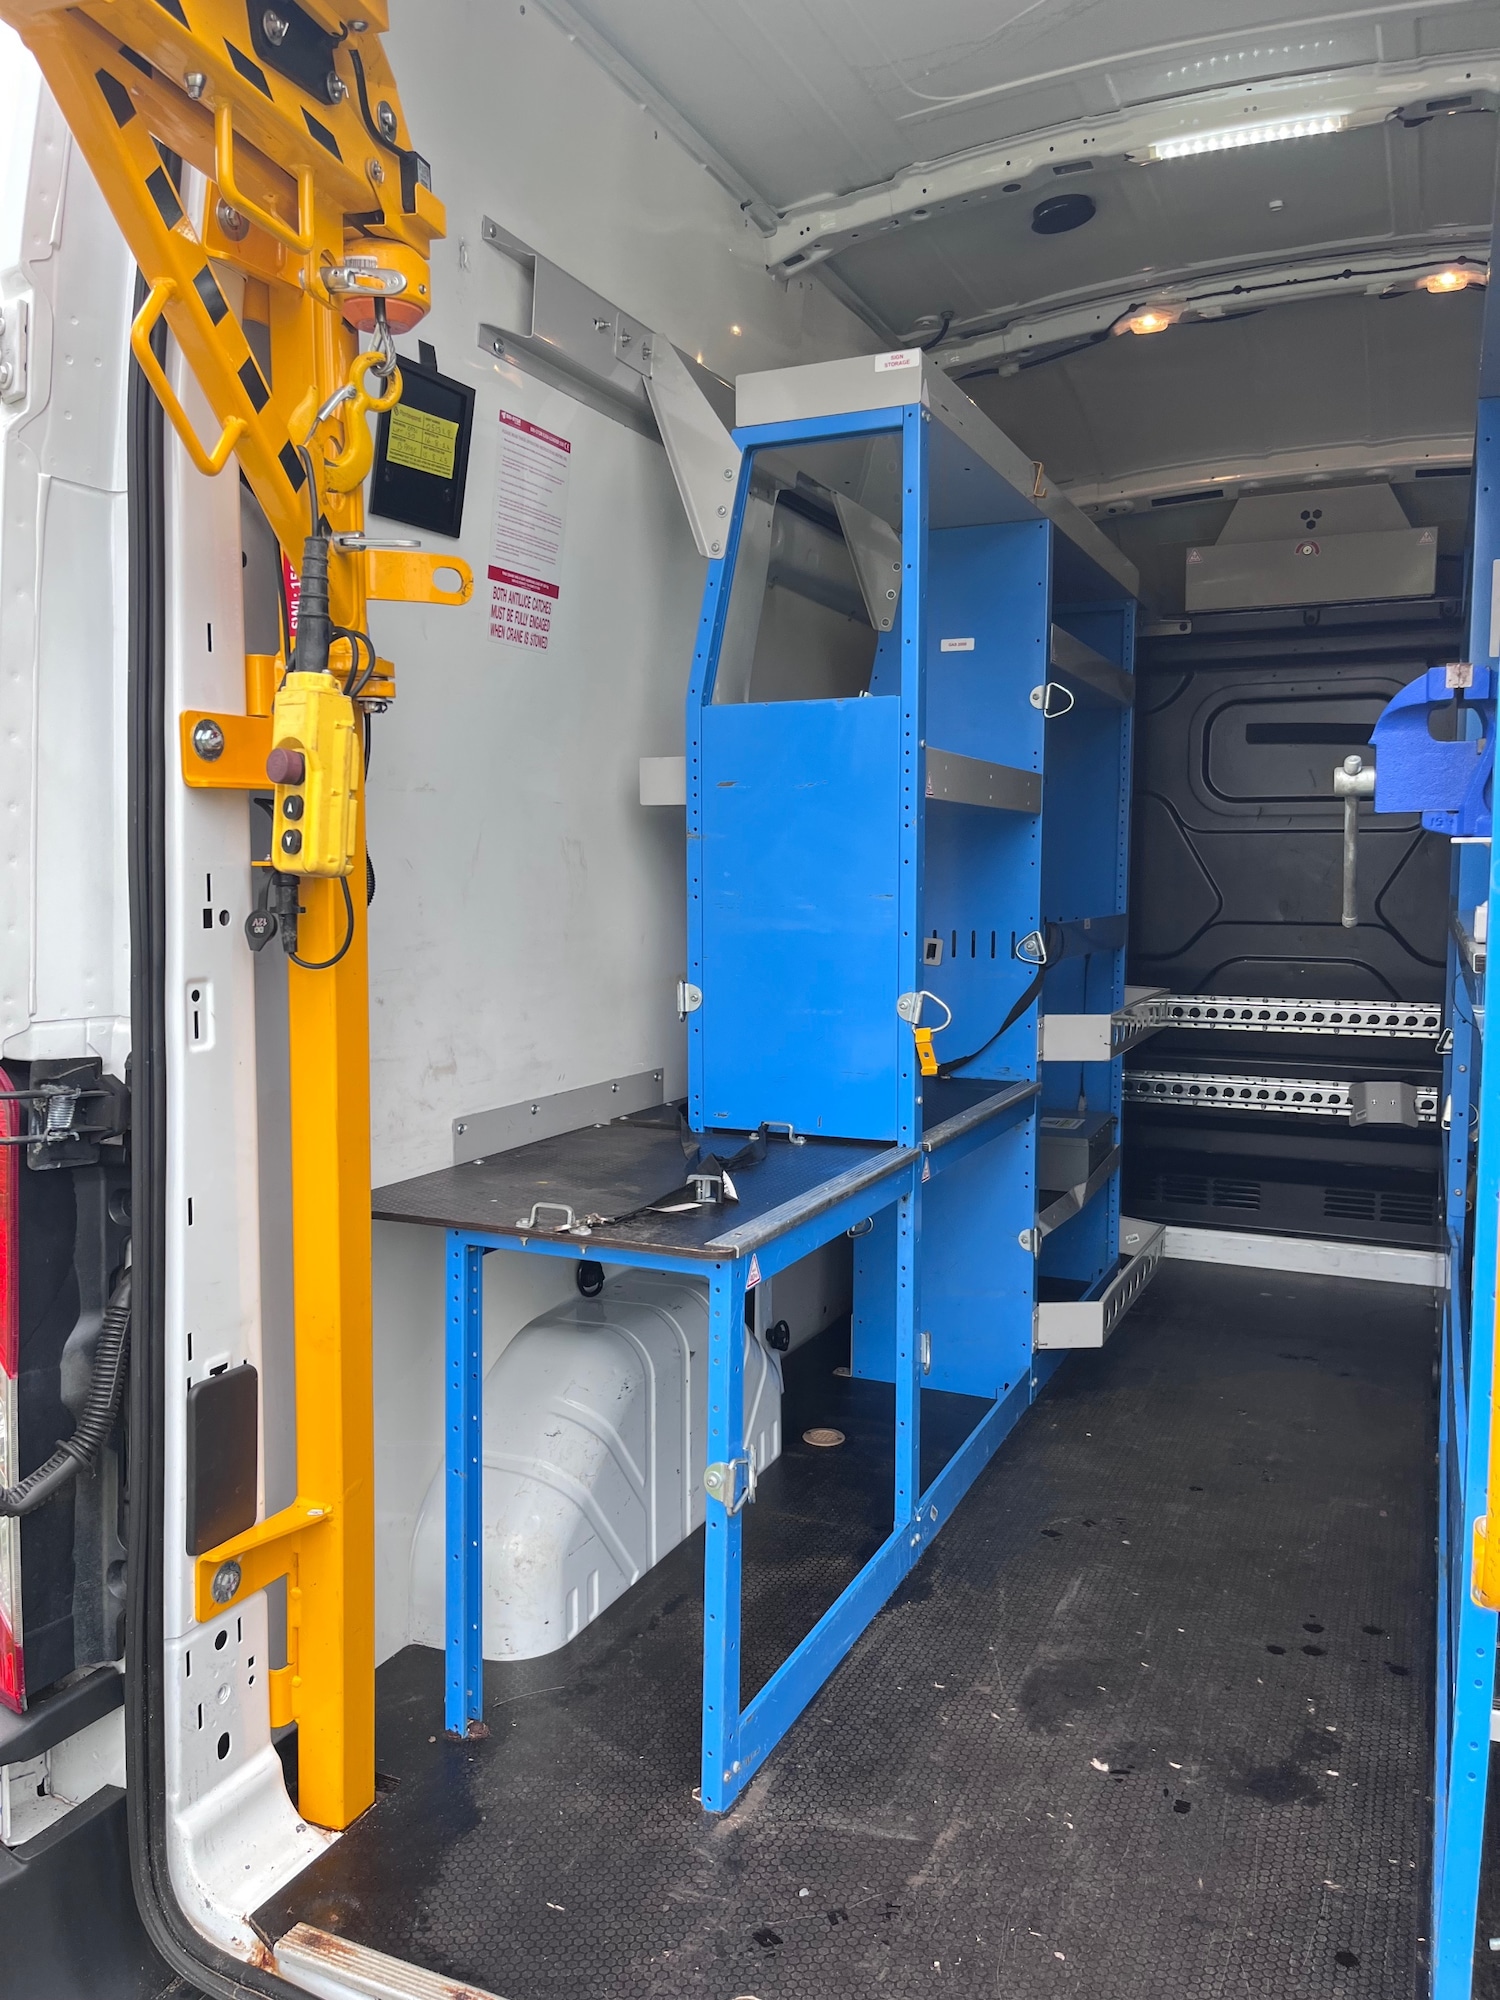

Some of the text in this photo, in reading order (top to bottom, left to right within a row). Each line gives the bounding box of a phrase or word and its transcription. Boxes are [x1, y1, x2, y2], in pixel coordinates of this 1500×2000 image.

[884, 359, 911, 368] STORAGE
[493, 586, 552, 615] BOTH ANTILUCE CATCHES
[491, 604, 550, 632] MUST BE FULLY ENGAGED
[490, 622, 548, 649] WHEN CRANE IS STOWED
